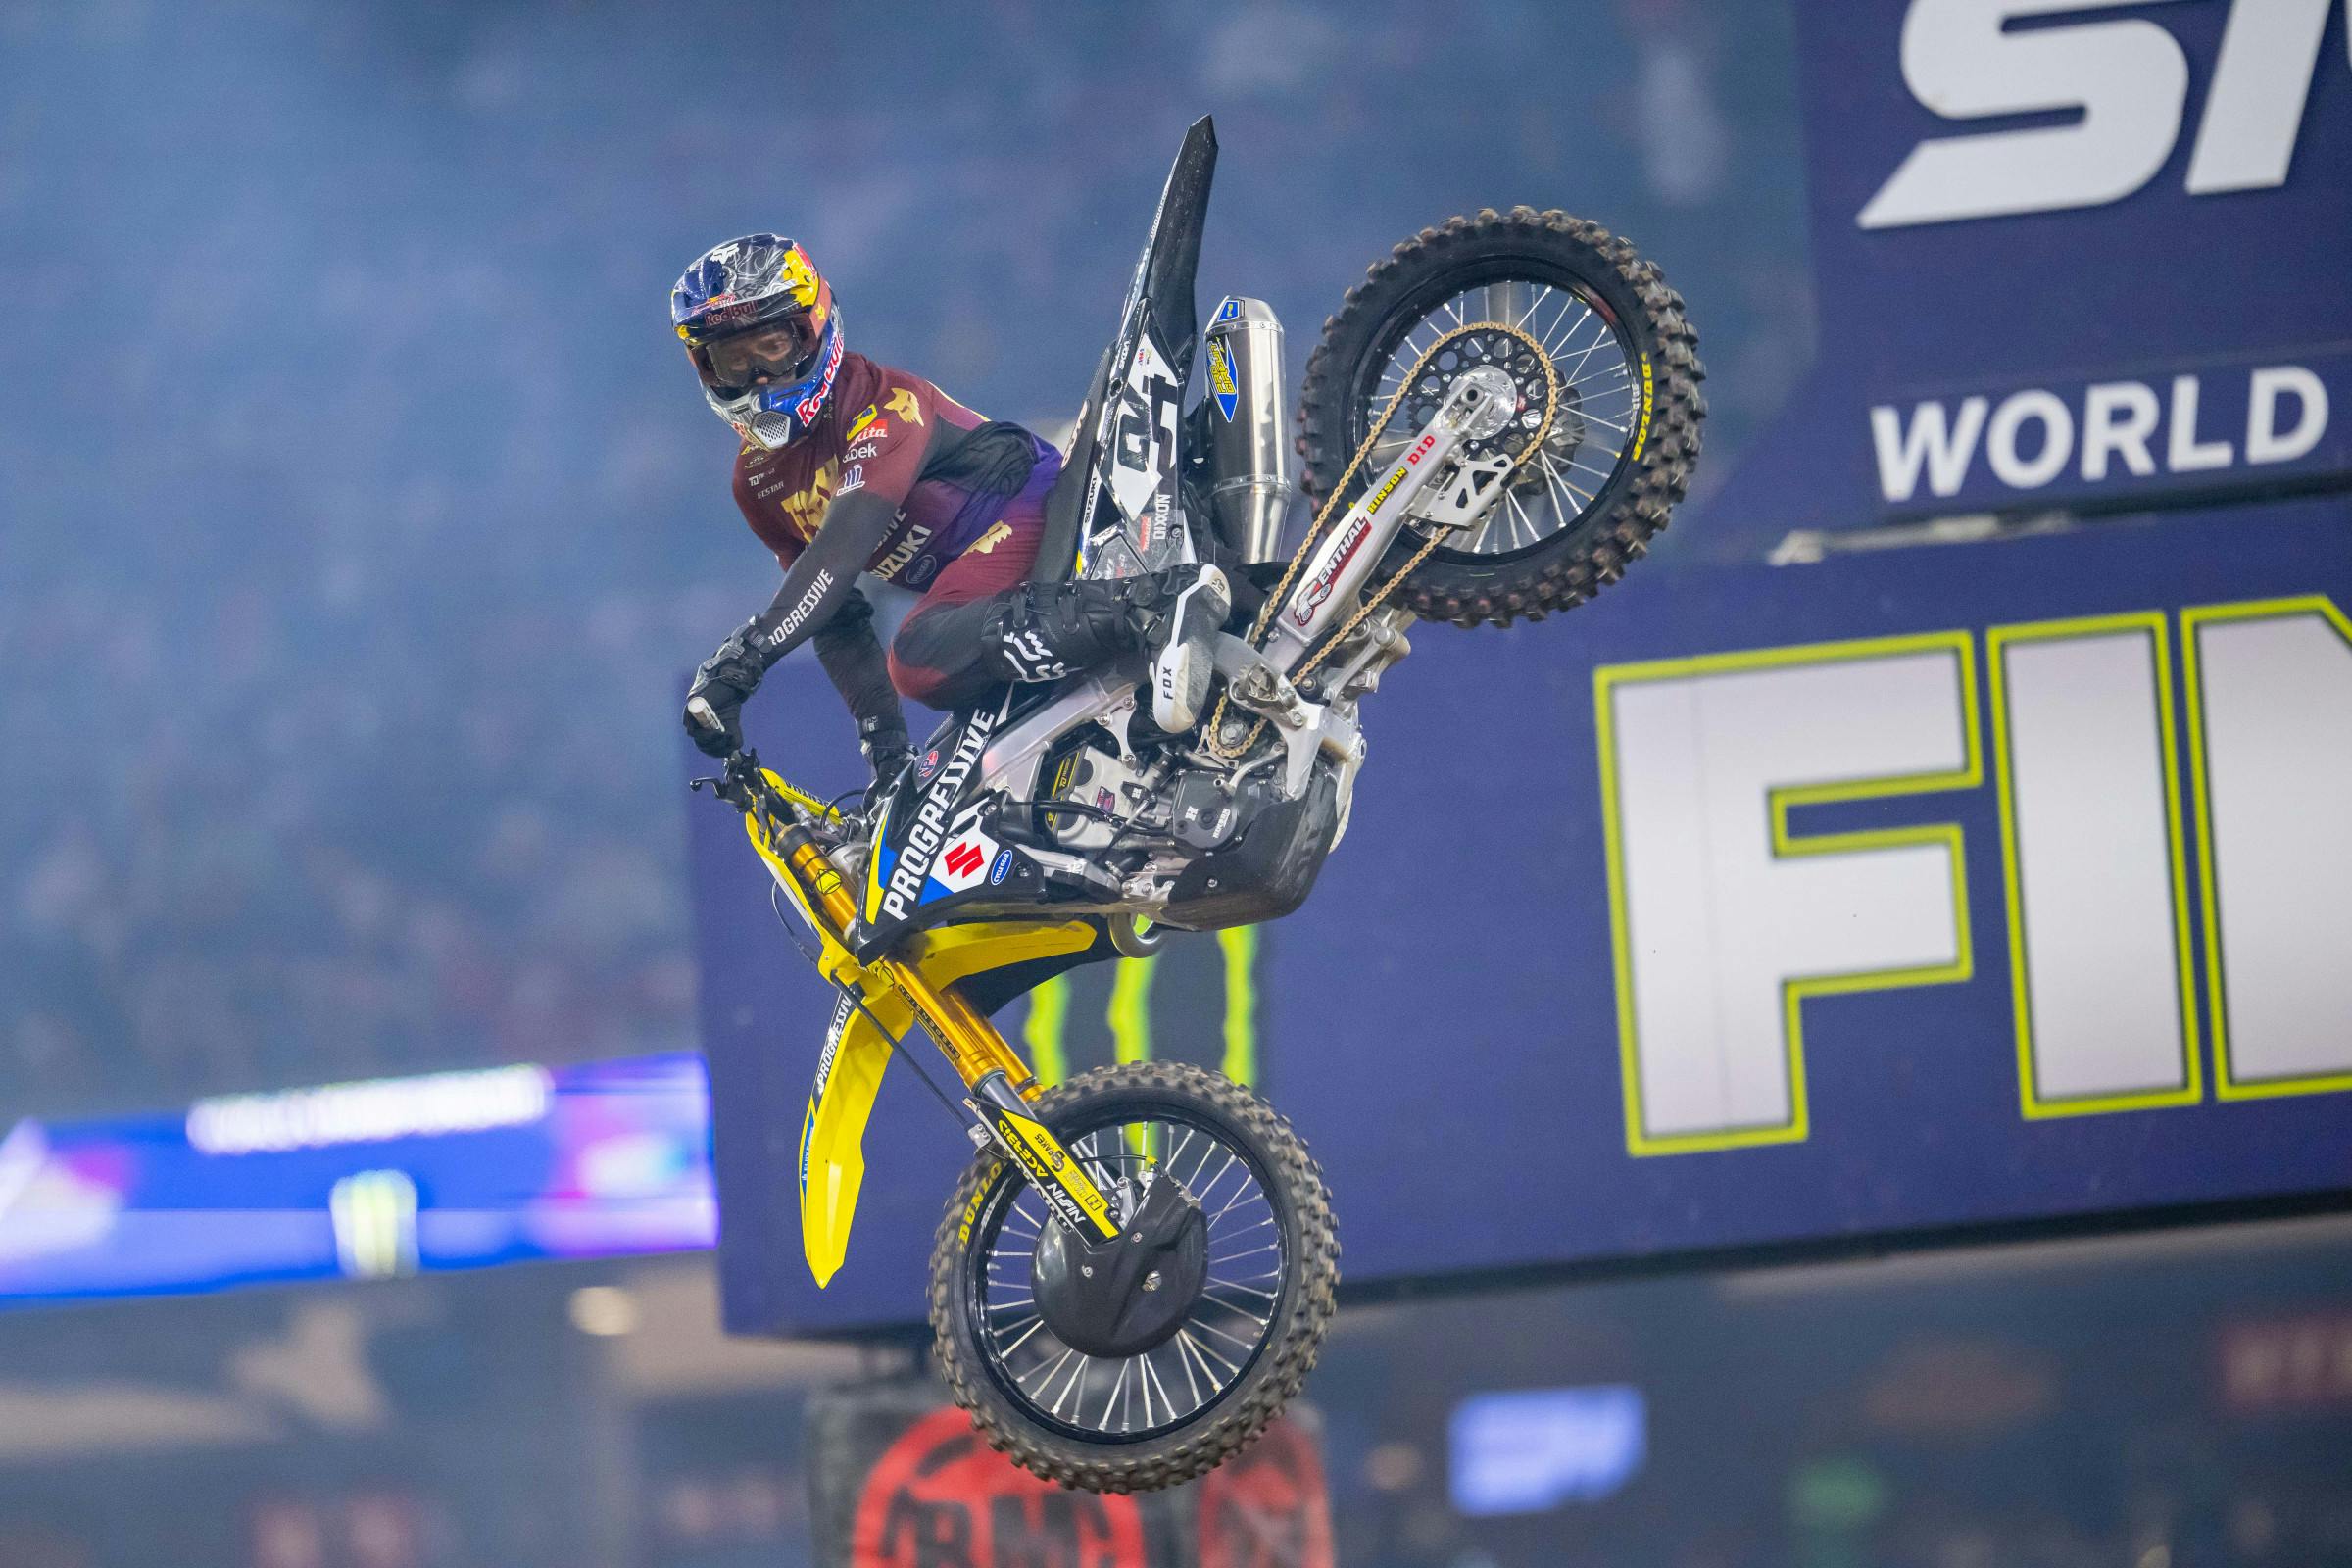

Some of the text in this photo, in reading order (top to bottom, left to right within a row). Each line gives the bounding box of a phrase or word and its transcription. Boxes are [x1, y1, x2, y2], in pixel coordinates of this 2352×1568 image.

[1856, 0, 2352, 230] S
[705, 306, 732, 326] Red
[1632, 362, 1654, 462] DUNLOP
[1871, 366, 2329, 502] WORLD
[1084, 477, 1097, 524] SUZUKI
[1367, 466, 1409, 514] HINSON
[1153, 493, 1173, 540] DIXXON
[1162, 667, 1173, 700] FOX
[994, 852, 1011, 883] CYCLE GEAR
[998, 1119, 1049, 1178] ACERBIS
[958, 1161, 1003, 1245] DUNLO
